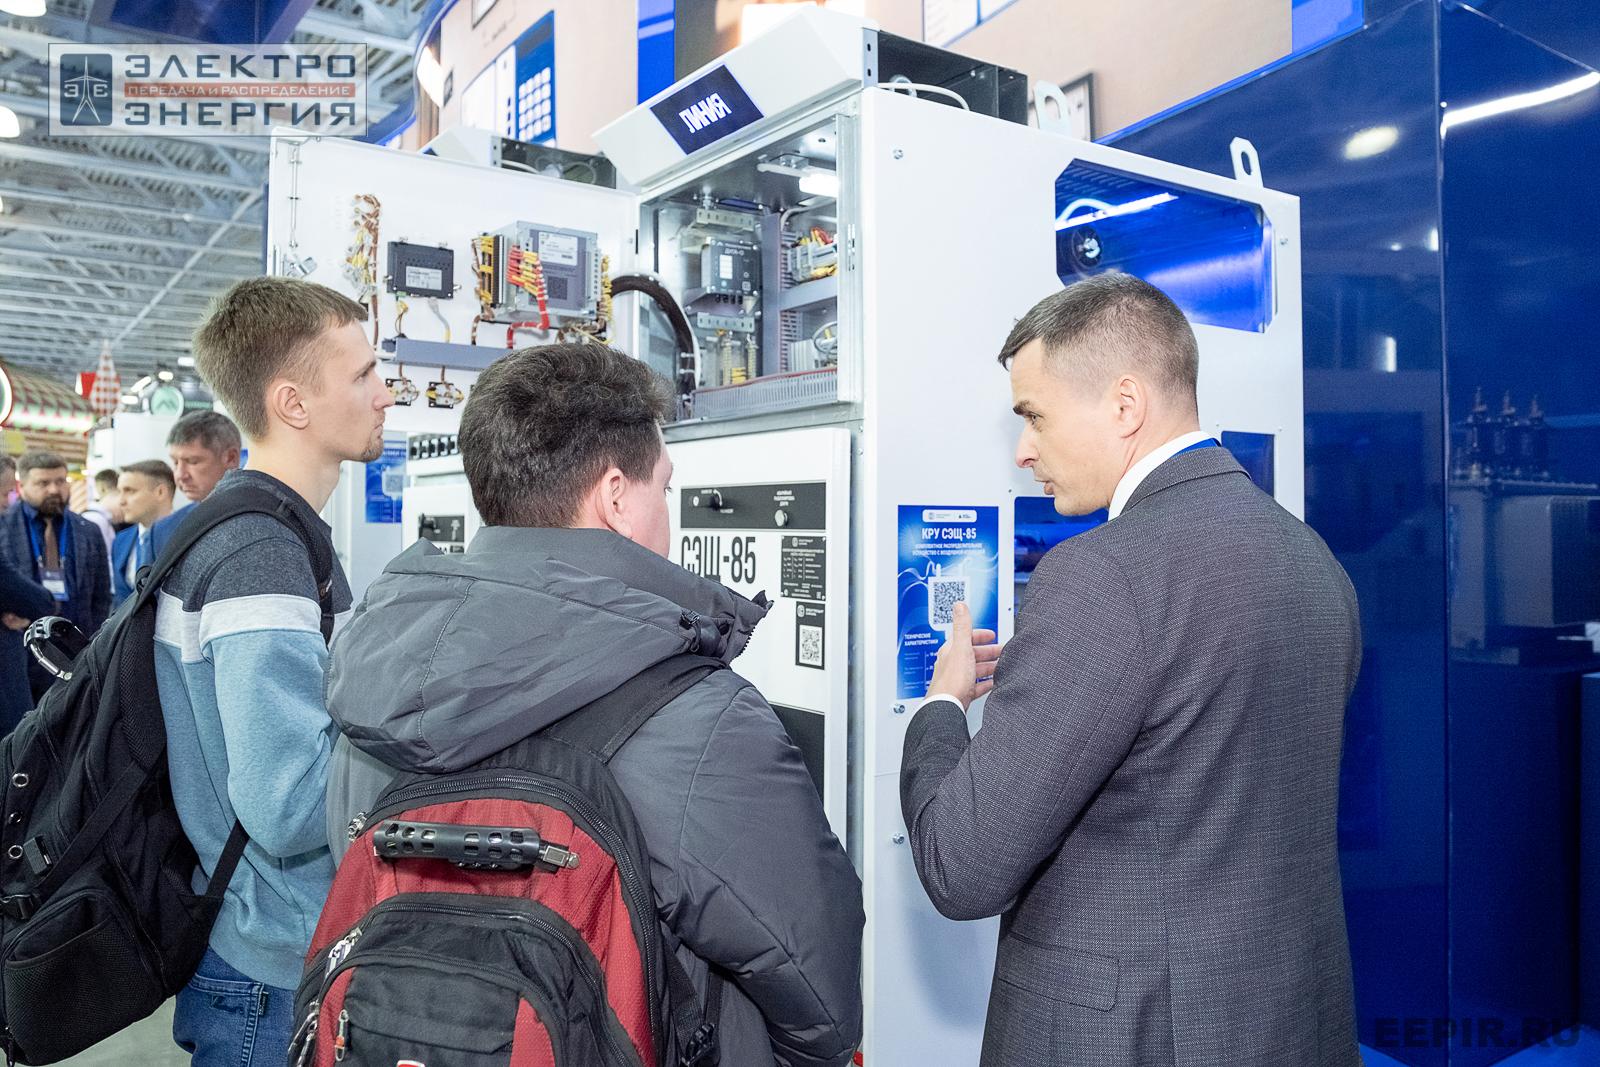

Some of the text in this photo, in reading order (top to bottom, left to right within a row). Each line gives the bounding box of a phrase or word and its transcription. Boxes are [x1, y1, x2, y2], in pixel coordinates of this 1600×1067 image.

[678, 92, 732, 134] ЛИНИЯ
[921, 527, 977, 541] КРУ СЭЩ-85
[681, 535, 756, 584] СЭЩ-85
